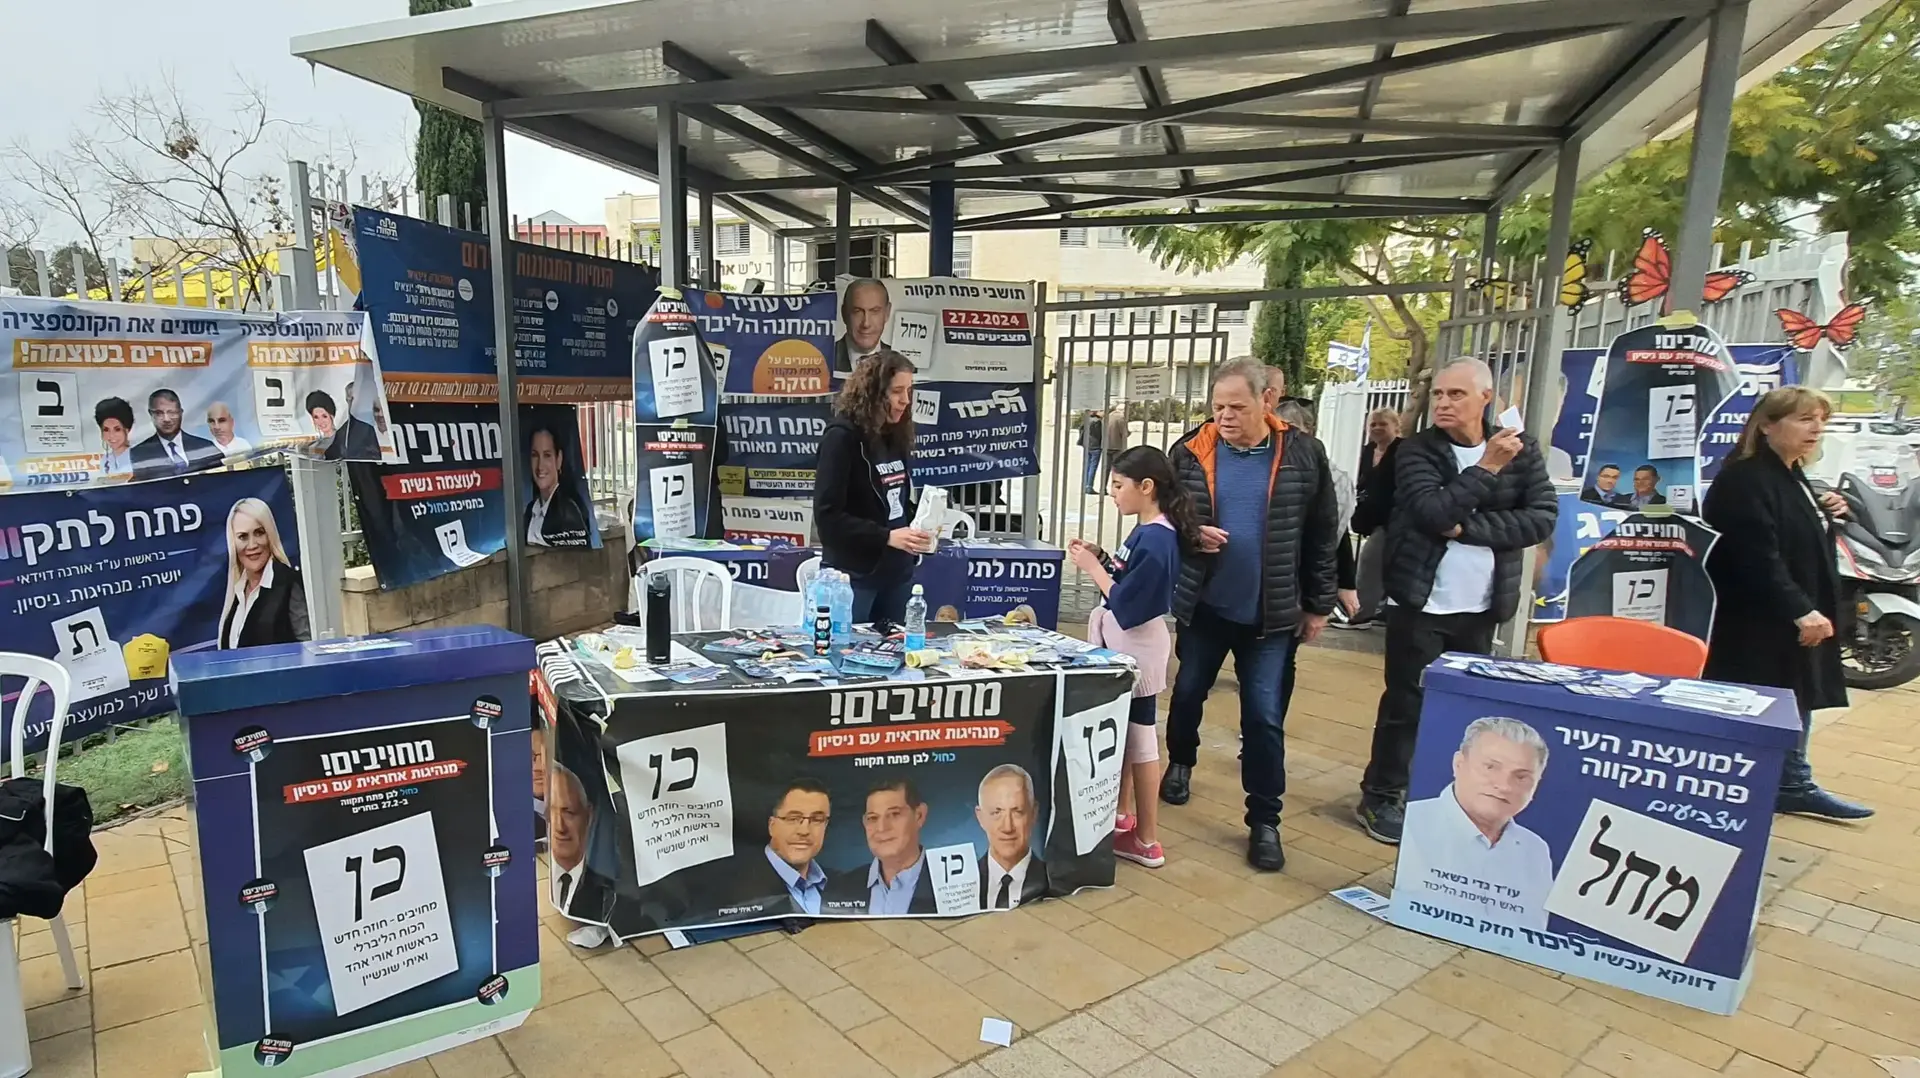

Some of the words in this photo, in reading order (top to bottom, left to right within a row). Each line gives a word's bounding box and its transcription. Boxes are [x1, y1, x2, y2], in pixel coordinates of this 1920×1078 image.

[904, 284, 946, 297] תקווה
[949, 285, 980, 298] פתח
[983, 286, 1026, 300] תושבי
[726, 295, 778, 313] עתיד
[783, 295, 811, 310] יש
[2, 311, 121, 337] הקונספציה
[126, 316, 155, 334] את
[161, 317, 220, 336] משנים
[698, 313, 760, 333] הליבר
[900, 316, 928, 339] מחל
[949, 311, 1020, 327] 27.2.2024
[326, 322, 343, 336] את
[976, 331, 1027, 343] מצביעים
[20, 341, 124, 364] בעוצמה!
[129, 342, 206, 365] בוחרים
[662, 346, 687, 377] כן
[767, 355, 782, 366] על
[784, 355, 822, 366] שומרים
[265, 376, 285, 408] ב
[407, 381, 419, 395] 10
[773, 376, 822, 394] חזקה
[36, 377, 66, 417] ב
[915, 393, 936, 417] מחל
[948, 387, 1028, 419] הליכוד
[1665, 394, 1695, 423] כן
[721, 415, 773, 439] תקוו
[778, 416, 827, 437] פתח
[965, 428, 989, 441] העיר
[991, 422, 1028, 440] למועצת
[941, 431, 964, 443] פתח
[988, 438, 1029, 452] בראשות
[729, 440, 777, 454] מאוחד
[948, 445, 964, 456] גדי
[911, 463, 957, 477] חברתית
[960, 460, 994, 473] עשייה
[996, 456, 1029, 469] 100%
[26, 471, 90, 487] בעוצמה
[400, 474, 434, 495] נשית
[436, 470, 482, 490] לעוצמה
[662, 474, 685, 505] כן
[410, 503, 427, 521] לבן
[427, 500, 450, 515] כחול
[450, 497, 485, 513] בתמיכת
[731, 507, 761, 519] פתח
[124, 502, 203, 541] פתח
[764, 509, 804, 522] תושבי
[0, 508, 116, 566] לתקוו
[442, 529, 459, 553] כן
[96, 558, 122, 573] עו"ד
[124, 550, 167, 567] בראשות
[16, 569, 54, 586] דוידאי
[57, 561, 94, 580] אורנה
[137, 569, 182, 590] יושרה.
[1009, 562, 1056, 579] פתח
[66, 577, 133, 605] מנהיגות.
[1628, 578, 1655, 605] כן
[12, 590, 61, 615] ניסיון.
[67, 620, 100, 656] ת
[128, 685, 159, 708] שלך
[830, 681, 1003, 726] מחויבים!
[64, 697, 125, 728] למועצת
[858, 733, 881, 746] עם
[884, 730, 940, 743] אחראית
[944, 726, 1000, 741] מנהיגות
[1554, 726, 1621, 755] העיר
[817, 735, 854, 753] ניסיון
[1082, 717, 1118, 780] כן
[320, 739, 436, 777] מחויבים!
[854, 756, 884, 769] תקווה
[887, 755, 910, 765] פתח
[912, 753, 930, 766] לבן
[931, 752, 956, 763] כחול
[1627, 738, 1757, 778] למועצת
[356, 769, 409, 789] אחראית
[411, 762, 459, 780] מנהיגות
[649, 747, 699, 800] כן
[1581, 756, 1667, 789] תקווה
[292, 783, 328, 801] ניסיון
[332, 778, 353, 793] עם
[385, 789, 399, 800] לבן
[400, 786, 419, 797] כחול
[1675, 774, 1750, 804] פתח
[340, 795, 364, 807] תקווה
[365, 792, 385, 802] פתח
[687, 799, 724, 810] מחויבים
[352, 803, 380, 814] בוחרים
[637, 806, 657, 820] חדש
[658, 802, 679, 813] חוזה
[686, 812, 711, 820] הכוח
[1646, 799, 1748, 833] מצביעים
[651, 812, 685, 830] הליברלי
[683, 821, 721, 835] בראשות
[644, 834, 663, 847] אהד
[664, 828, 681, 839] אורי
[687, 834, 709, 847] ואיתי
[940, 854, 965, 884] כן
[1429, 867, 1470, 886] בשארי
[1578, 814, 1701, 931] מחל
[345, 844, 407, 923] כן
[1422, 879, 1457, 898] הליכוד
[1471, 877, 1491, 892] גדי
[1493, 882, 1521, 898] עו"ד
[1460, 889, 1497, 907] רשימת
[396, 900, 438, 923] מחויבים
[1409, 900, 1475, 928] במועצה
[1499, 900, 1525, 915] ראש
[362, 918, 388, 936] חוזה
[399, 921, 426, 939] הכוח
[1478, 919, 1515, 939] חזק
[333, 928, 361, 945] חדש
[353, 931, 397, 954] הליברלי
[396, 932, 440, 956] בראשות
[1519, 925, 1600, 958] ליכוד
[371, 949, 394, 964] אורי
[402, 952, 429, 967] ואיתי
[1593, 949, 1652, 974] עכשיו
[344, 958, 370, 974] אהד
[361, 962, 400, 987] שונשיין
[1655, 966, 1717, 992] דווקא
